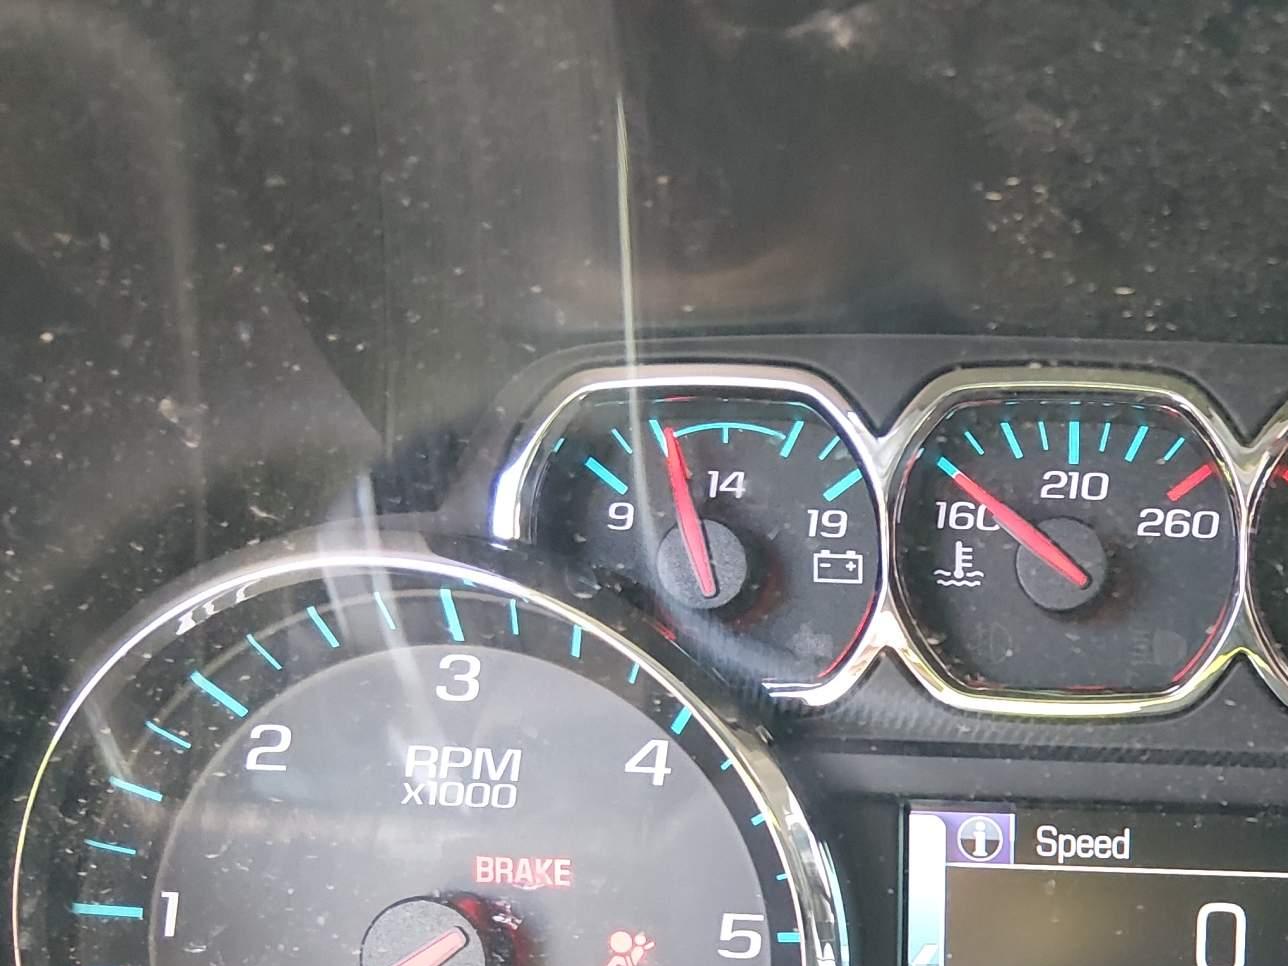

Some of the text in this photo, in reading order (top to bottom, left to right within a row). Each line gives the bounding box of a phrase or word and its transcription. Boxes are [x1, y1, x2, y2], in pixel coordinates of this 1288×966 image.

[708, 471, 745, 498] 14
[1040, 472, 1108, 500] 210
[607, 503, 633, 531] 9
[809, 510, 847, 537] 19
[1137, 510, 1219, 538] 260
[436, 655, 480, 701] 3
[246, 725, 291, 771] 2
[404, 746, 521, 781] RPM
[626, 740, 671, 785] 4
[1037, 826, 1130, 861] Speed
[475, 857, 572, 886] BRAKE
[161, 892, 178, 937] 1
[719, 914, 764, 959] 5
